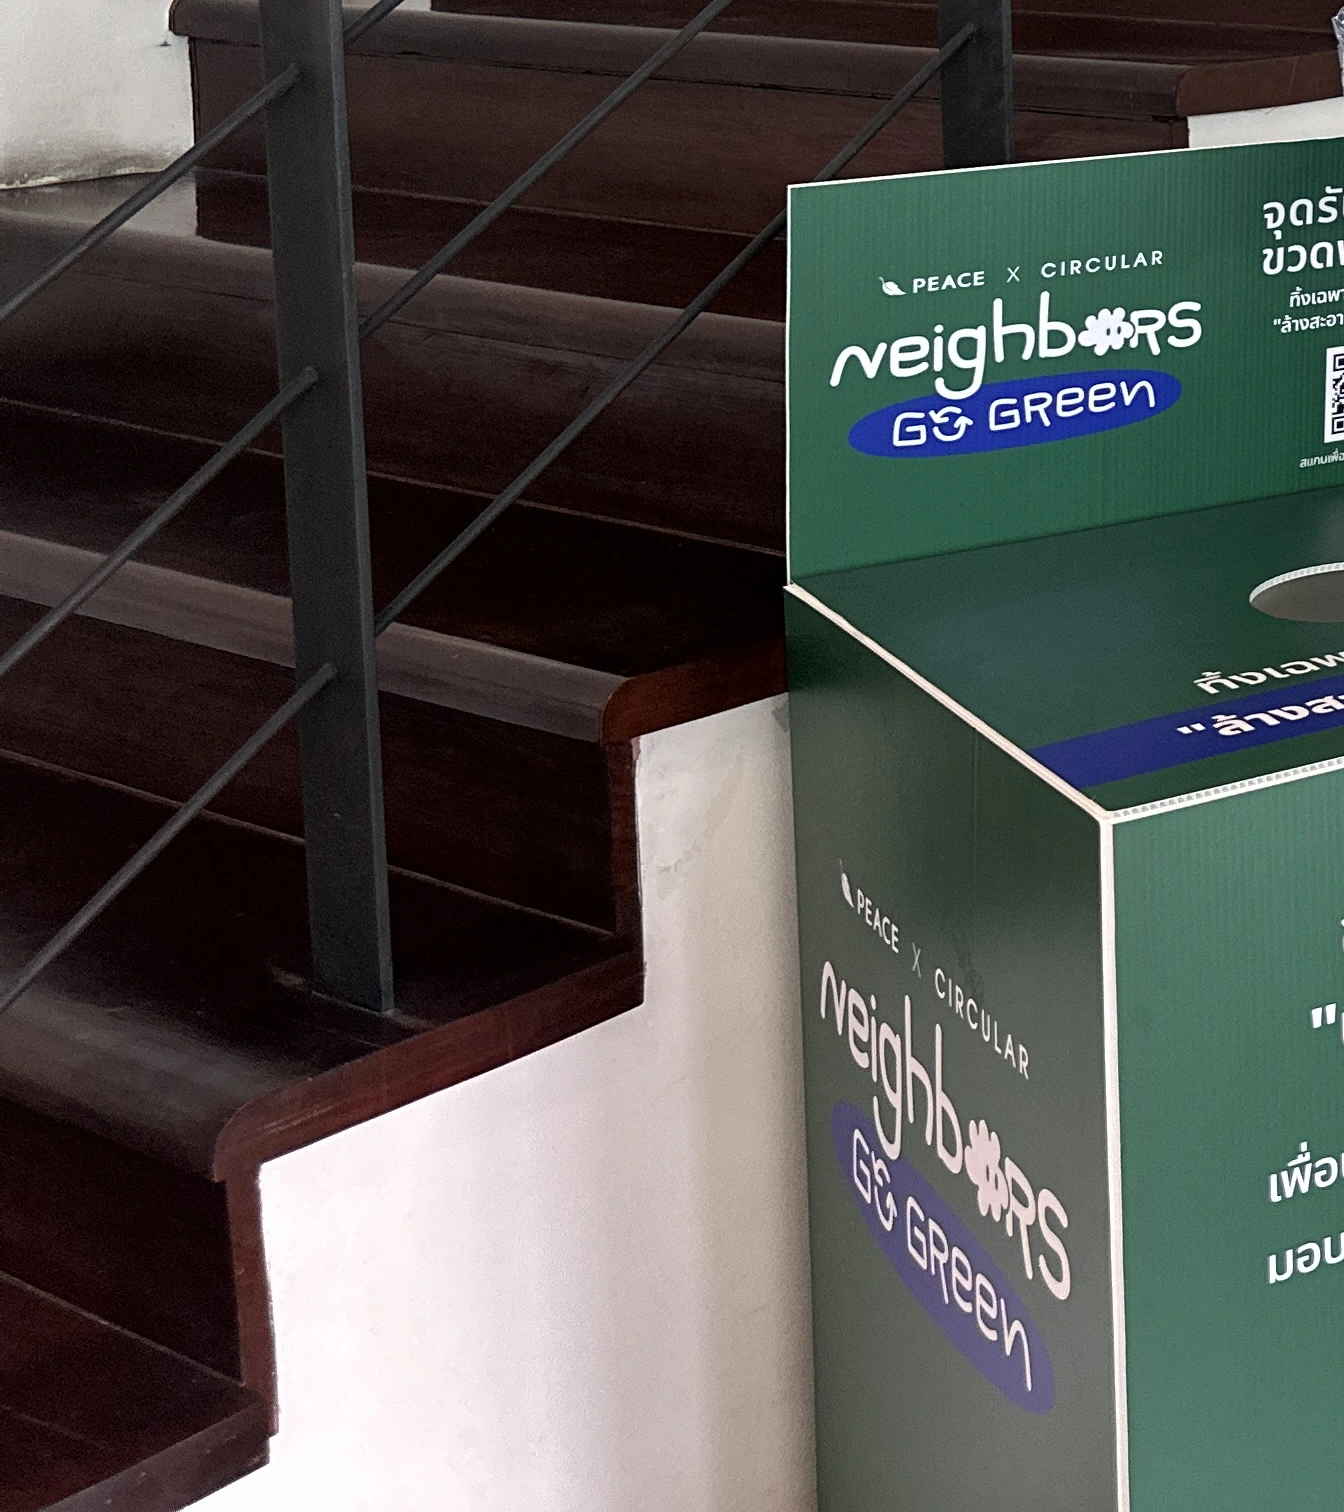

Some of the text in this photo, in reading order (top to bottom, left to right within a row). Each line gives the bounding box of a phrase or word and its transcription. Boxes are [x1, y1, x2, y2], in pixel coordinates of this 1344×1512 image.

[912, 270, 985, 294] PEACE
[1040, 250, 1163, 279] CIRCULAR
[856, 888, 899, 954] PEACE
[934, 968, 1029, 1080] CIRCULAR
